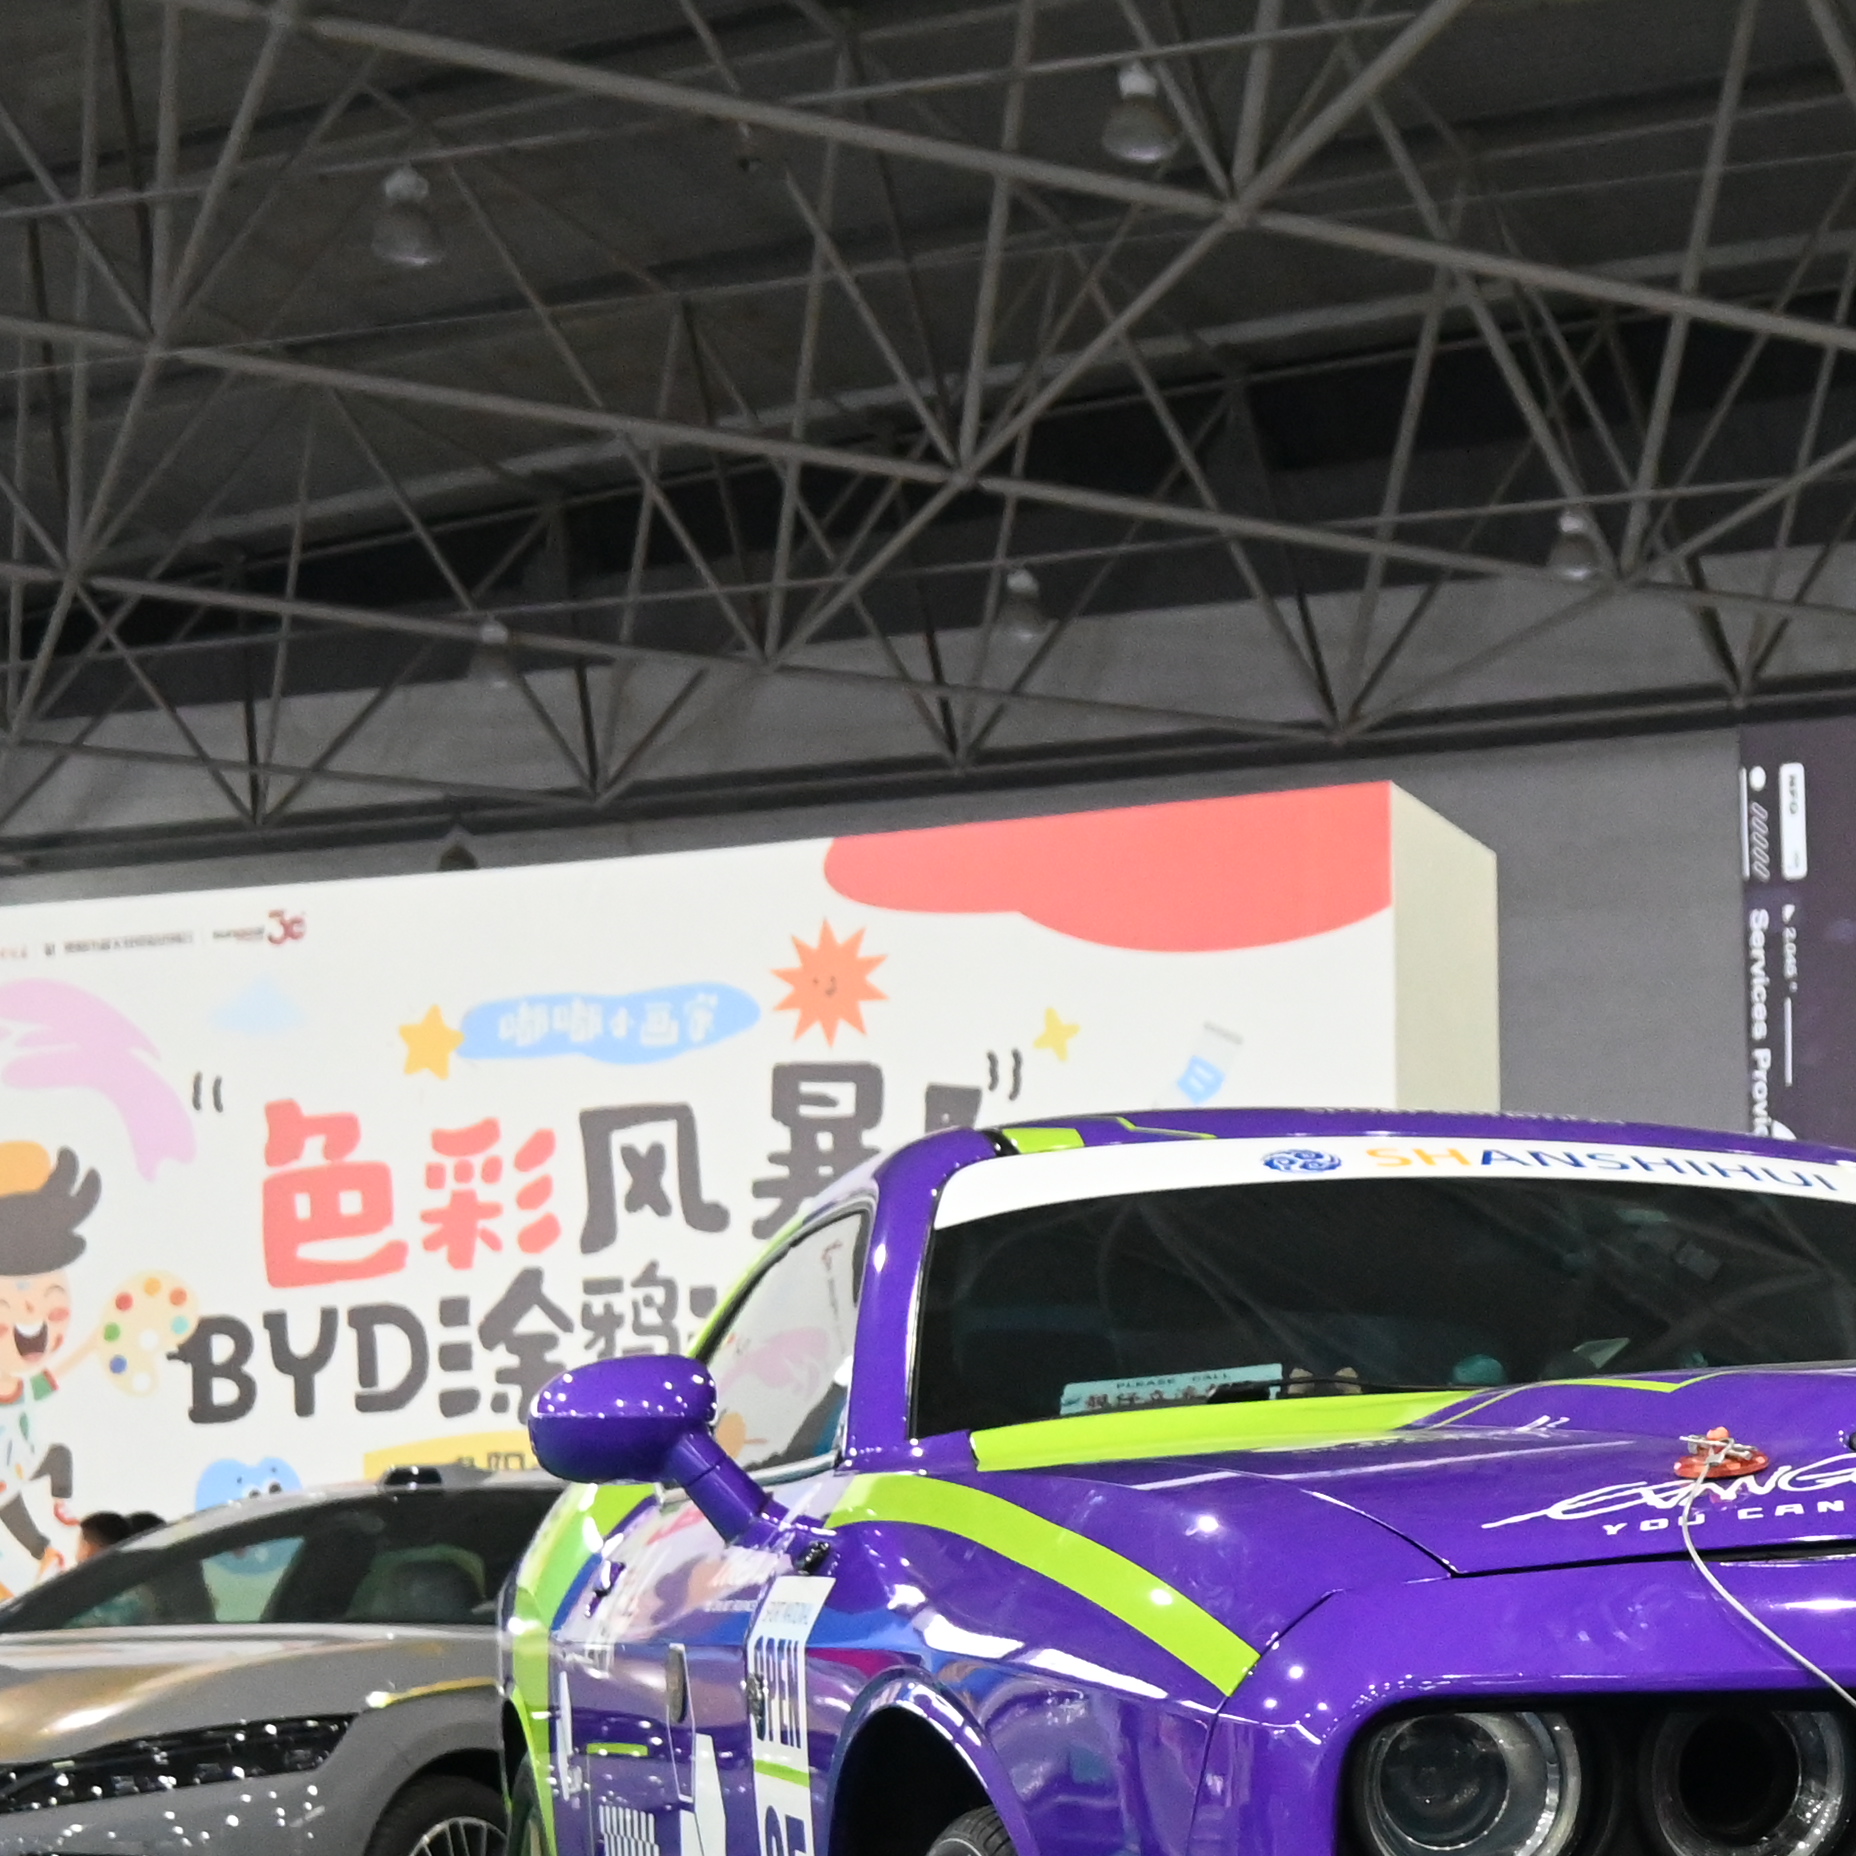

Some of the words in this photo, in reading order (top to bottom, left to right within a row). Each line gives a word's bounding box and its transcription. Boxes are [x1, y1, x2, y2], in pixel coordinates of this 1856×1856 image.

[1749, 907, 1770, 1041] Services
[262, 1060, 983, 1289] 色彩风暴
[1366, 1147, 1839, 1192] SHANSHIHUI
[172, 1259, 717, 1426] BYD涂鸦
[1602, 1513, 1706, 1536] YOU
